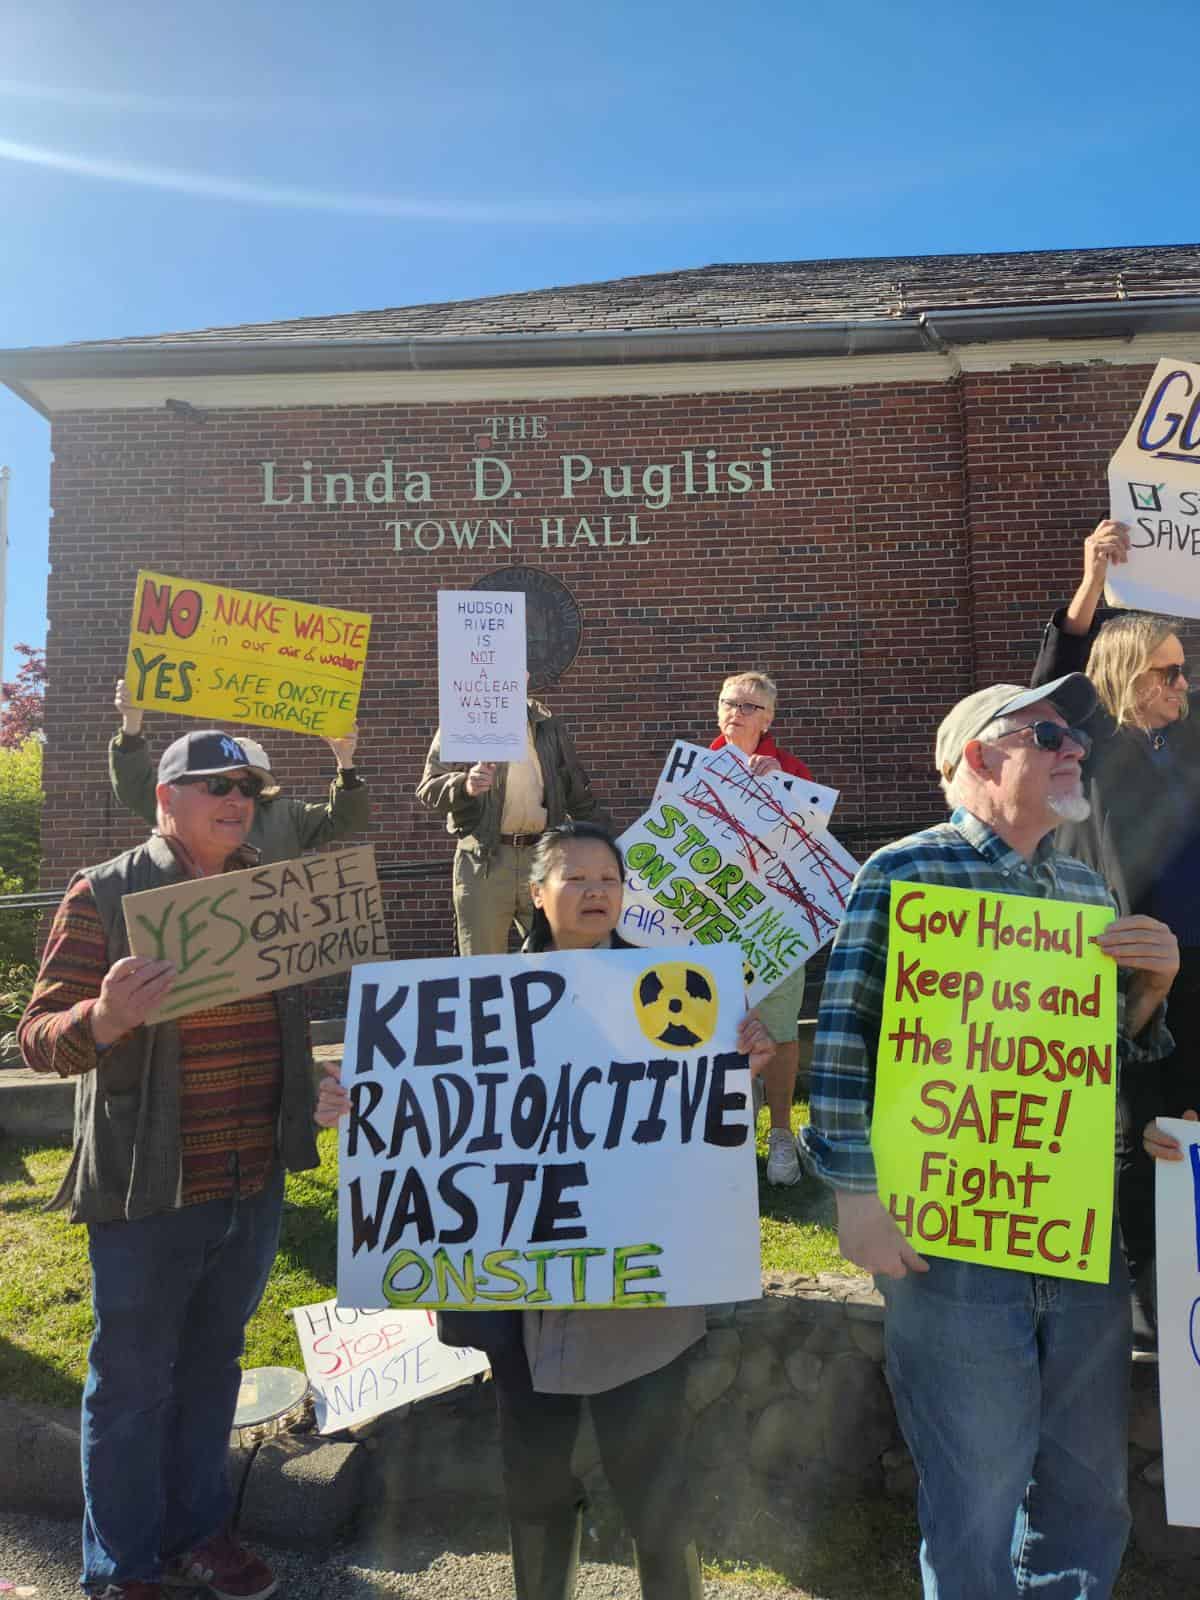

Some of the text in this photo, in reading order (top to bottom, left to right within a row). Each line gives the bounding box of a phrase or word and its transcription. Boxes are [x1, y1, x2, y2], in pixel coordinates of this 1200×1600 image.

[485, 416, 548, 440] THE
[260, 448, 776, 510] Linda D. Puglisi
[385, 515, 651, 551] TOWN HALL
[214, 593, 287, 635] NUKE
[294, 611, 369, 649] WASTE
[458, 601, 513, 615] HUDSON
[464, 618, 505, 631] RIVER
[470, 650, 496, 665] NOT
[476, 634, 491, 648] IS
[208, 668, 272, 696] SAFE
[453, 680, 519, 693] NUCLEAR
[479, 667, 489, 680] A
[232, 696, 328, 731] STORAGE
[460, 696, 510, 709] WASTE
[467, 711, 498, 725] SITE
[250, 852, 365, 900] SAFE
[643, 804, 767, 920] STORE
[137, 888, 248, 974] YES
[251, 886, 378, 942] ON-SITE
[624, 904, 665, 936] AIR
[744, 905, 808, 968] NUKE
[896, 891, 970, 943] Gov
[256, 919, 391, 981] STORAGE
[355, 970, 566, 1073] KEEP
[993, 978, 1030, 1011] us
[1040, 975, 1101, 1018] and
[889, 1017, 1112, 1086] the HUDSON
[347, 1052, 750, 1159] RADIOACTIVE
[911, 1080, 1072, 1154] SAFE!
[920, 1151, 1050, 1208] Fight
[348, 1161, 589, 1258] WASTE
[888, 1193, 1097, 1271] HOLTEC!
[321, 1336, 439, 1416] WASTE
